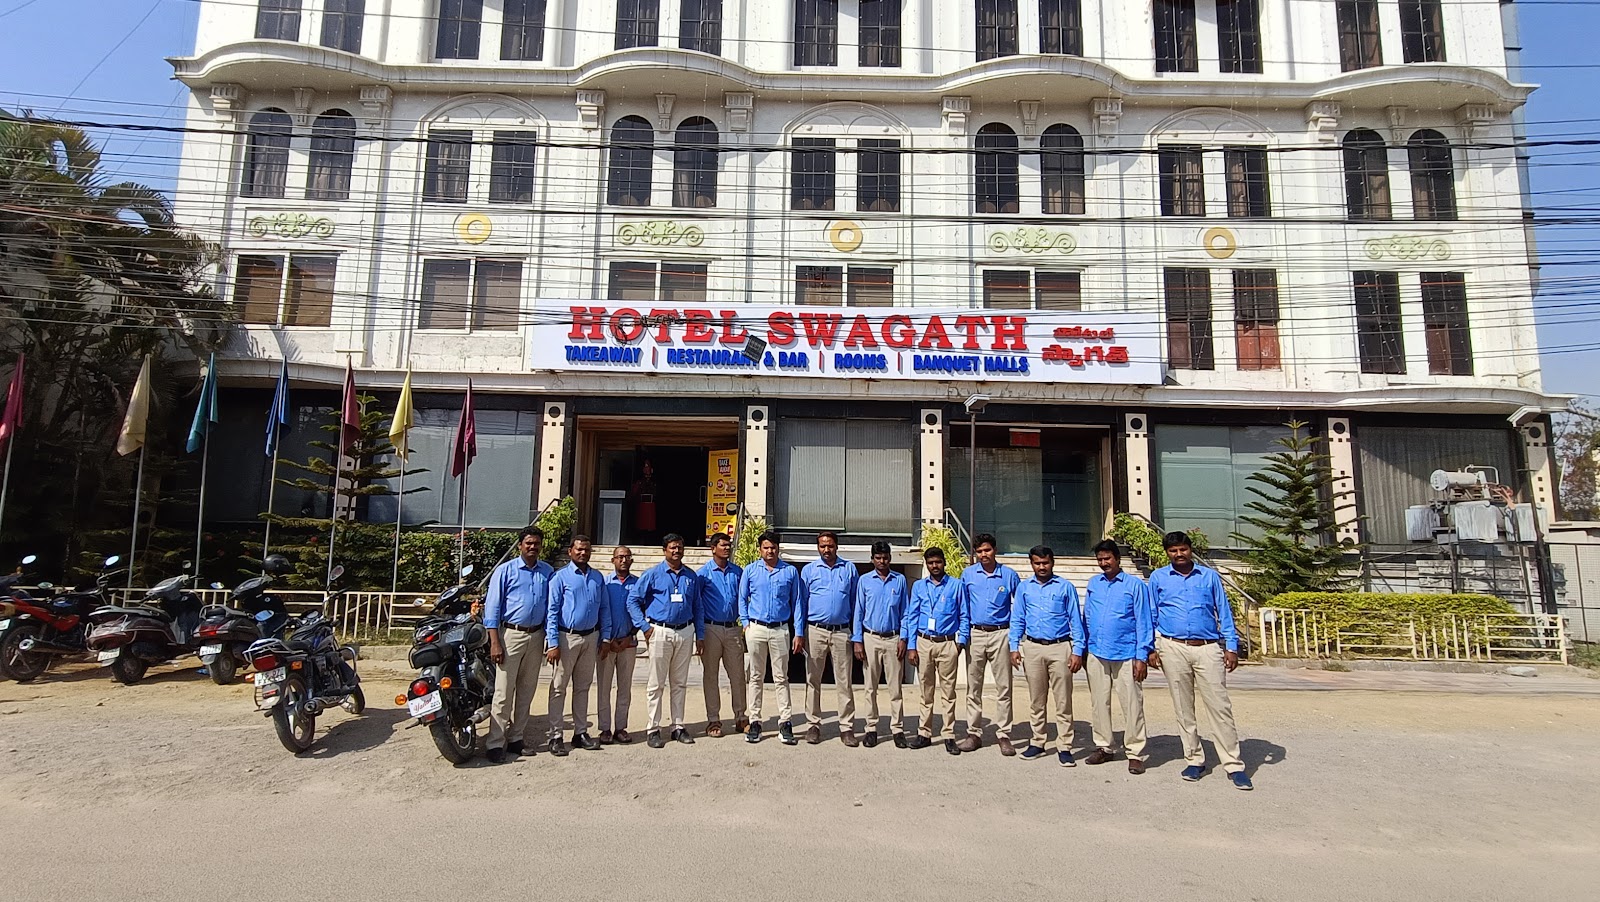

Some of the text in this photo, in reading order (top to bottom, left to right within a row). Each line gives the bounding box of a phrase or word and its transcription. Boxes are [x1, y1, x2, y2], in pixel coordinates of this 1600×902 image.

[567, 305, 1028, 352] HOTEL SWAGATH
[564, 345, 642, 364] TAKEAWAY
[666, 348, 808, 368] RESTAURAN & BAR
[834, 353, 887, 370] ROOMS
[913, 354, 1029, 373] BANQUET HALLS
